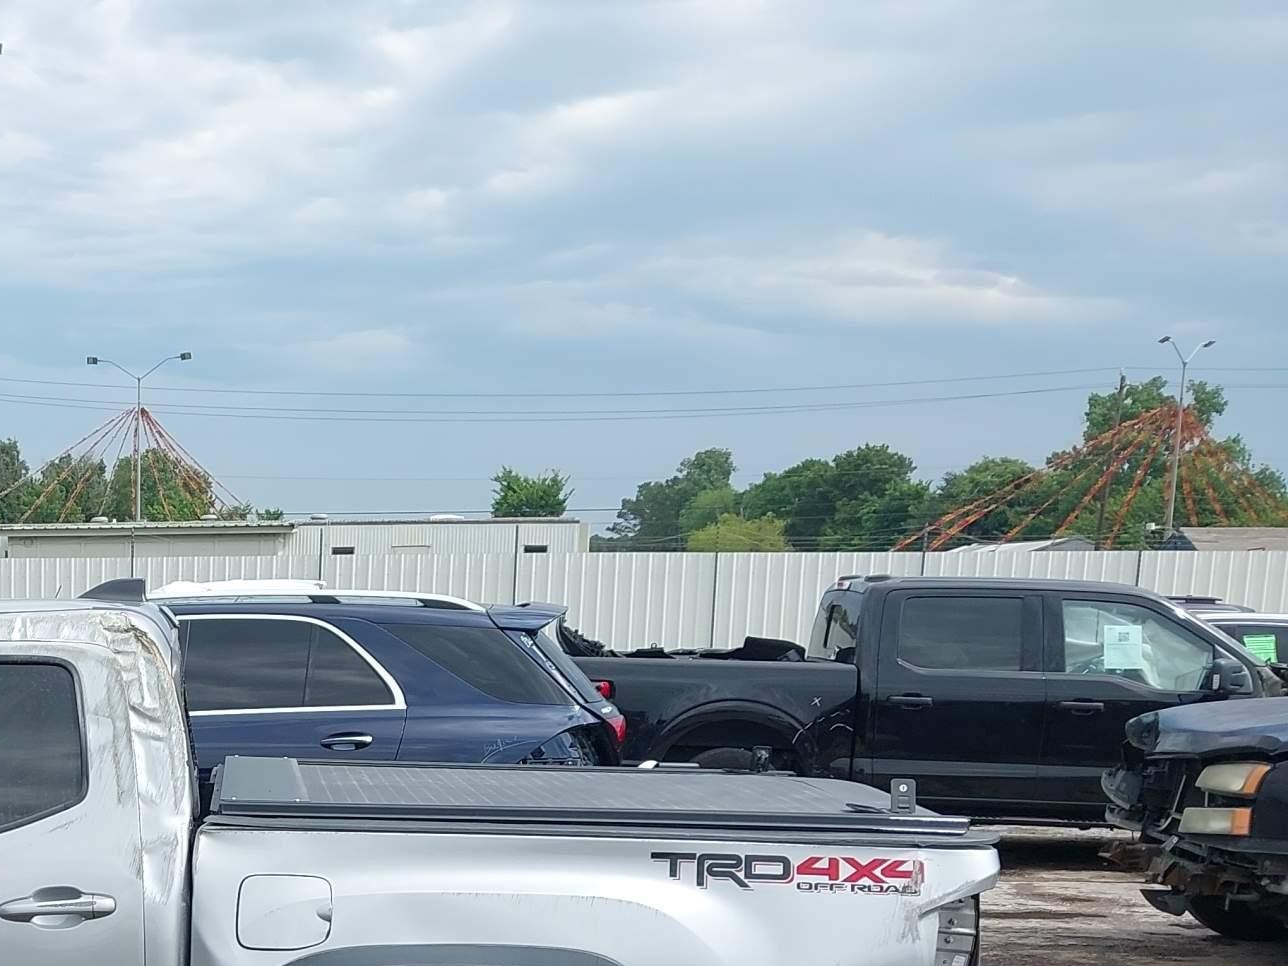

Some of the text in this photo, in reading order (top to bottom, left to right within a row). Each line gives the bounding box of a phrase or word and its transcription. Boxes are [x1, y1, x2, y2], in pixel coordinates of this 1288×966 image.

[650, 852, 794, 890] TRD
[796, 881, 920, 897] OFF ROAD
